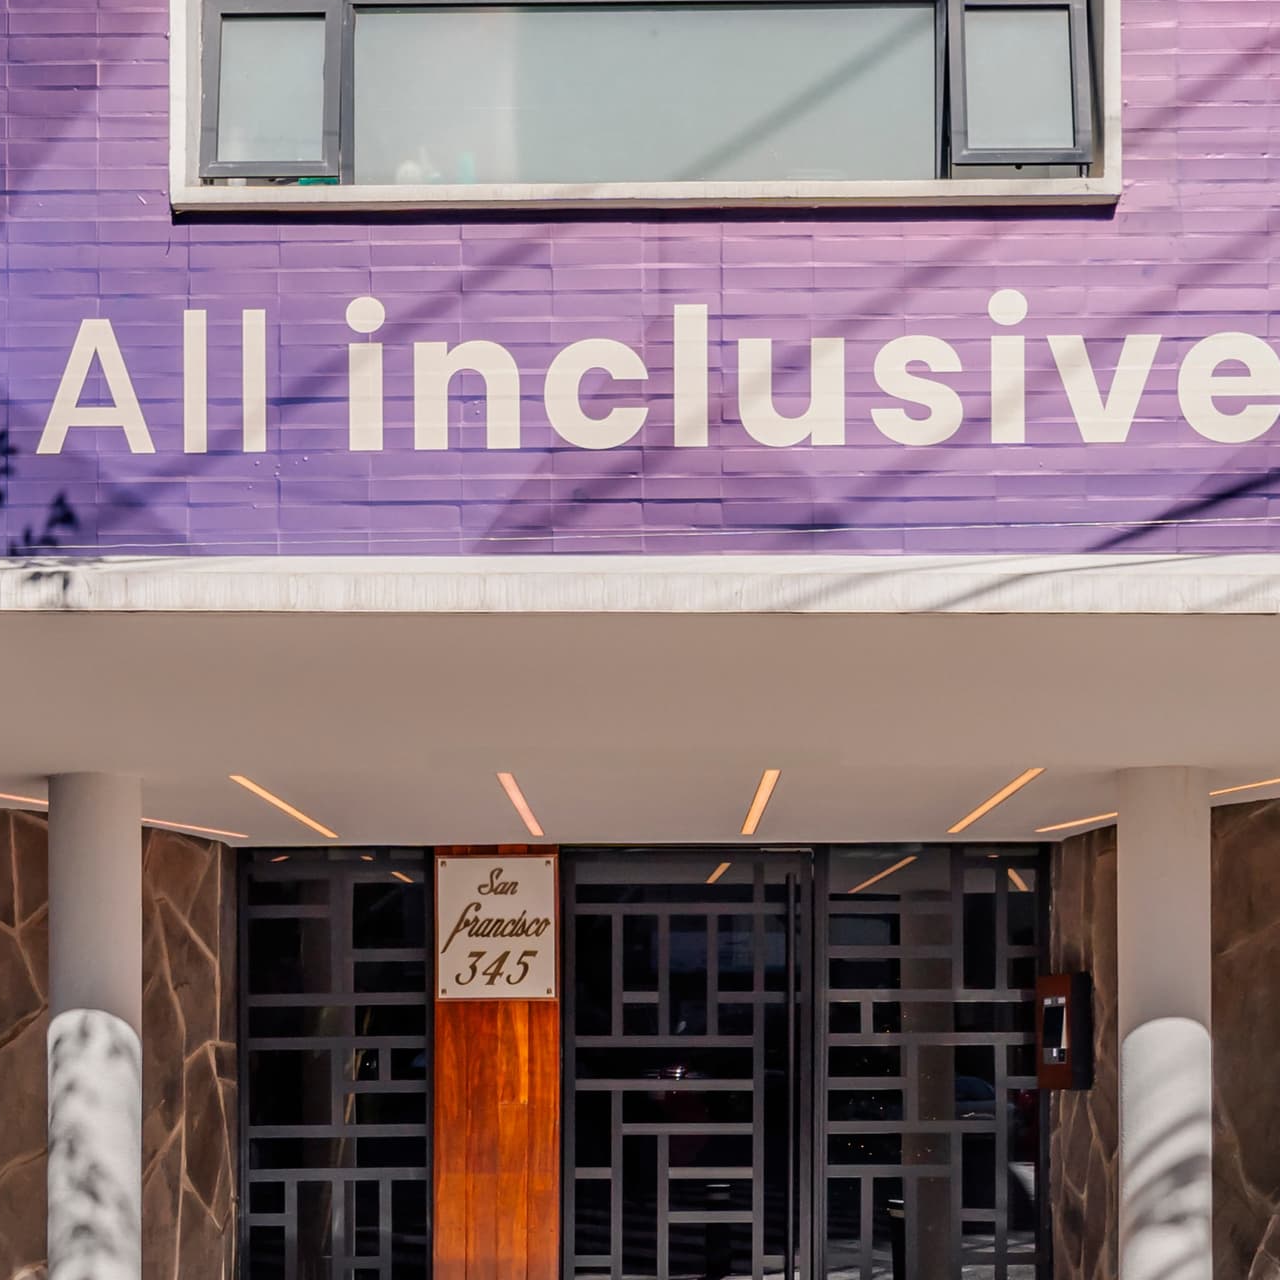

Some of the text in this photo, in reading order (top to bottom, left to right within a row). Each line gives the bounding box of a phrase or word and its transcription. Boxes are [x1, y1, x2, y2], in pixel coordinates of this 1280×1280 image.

[35, 307, 267, 456] All
[477, 867, 519, 895] San
[454, 950, 539, 986] 345
